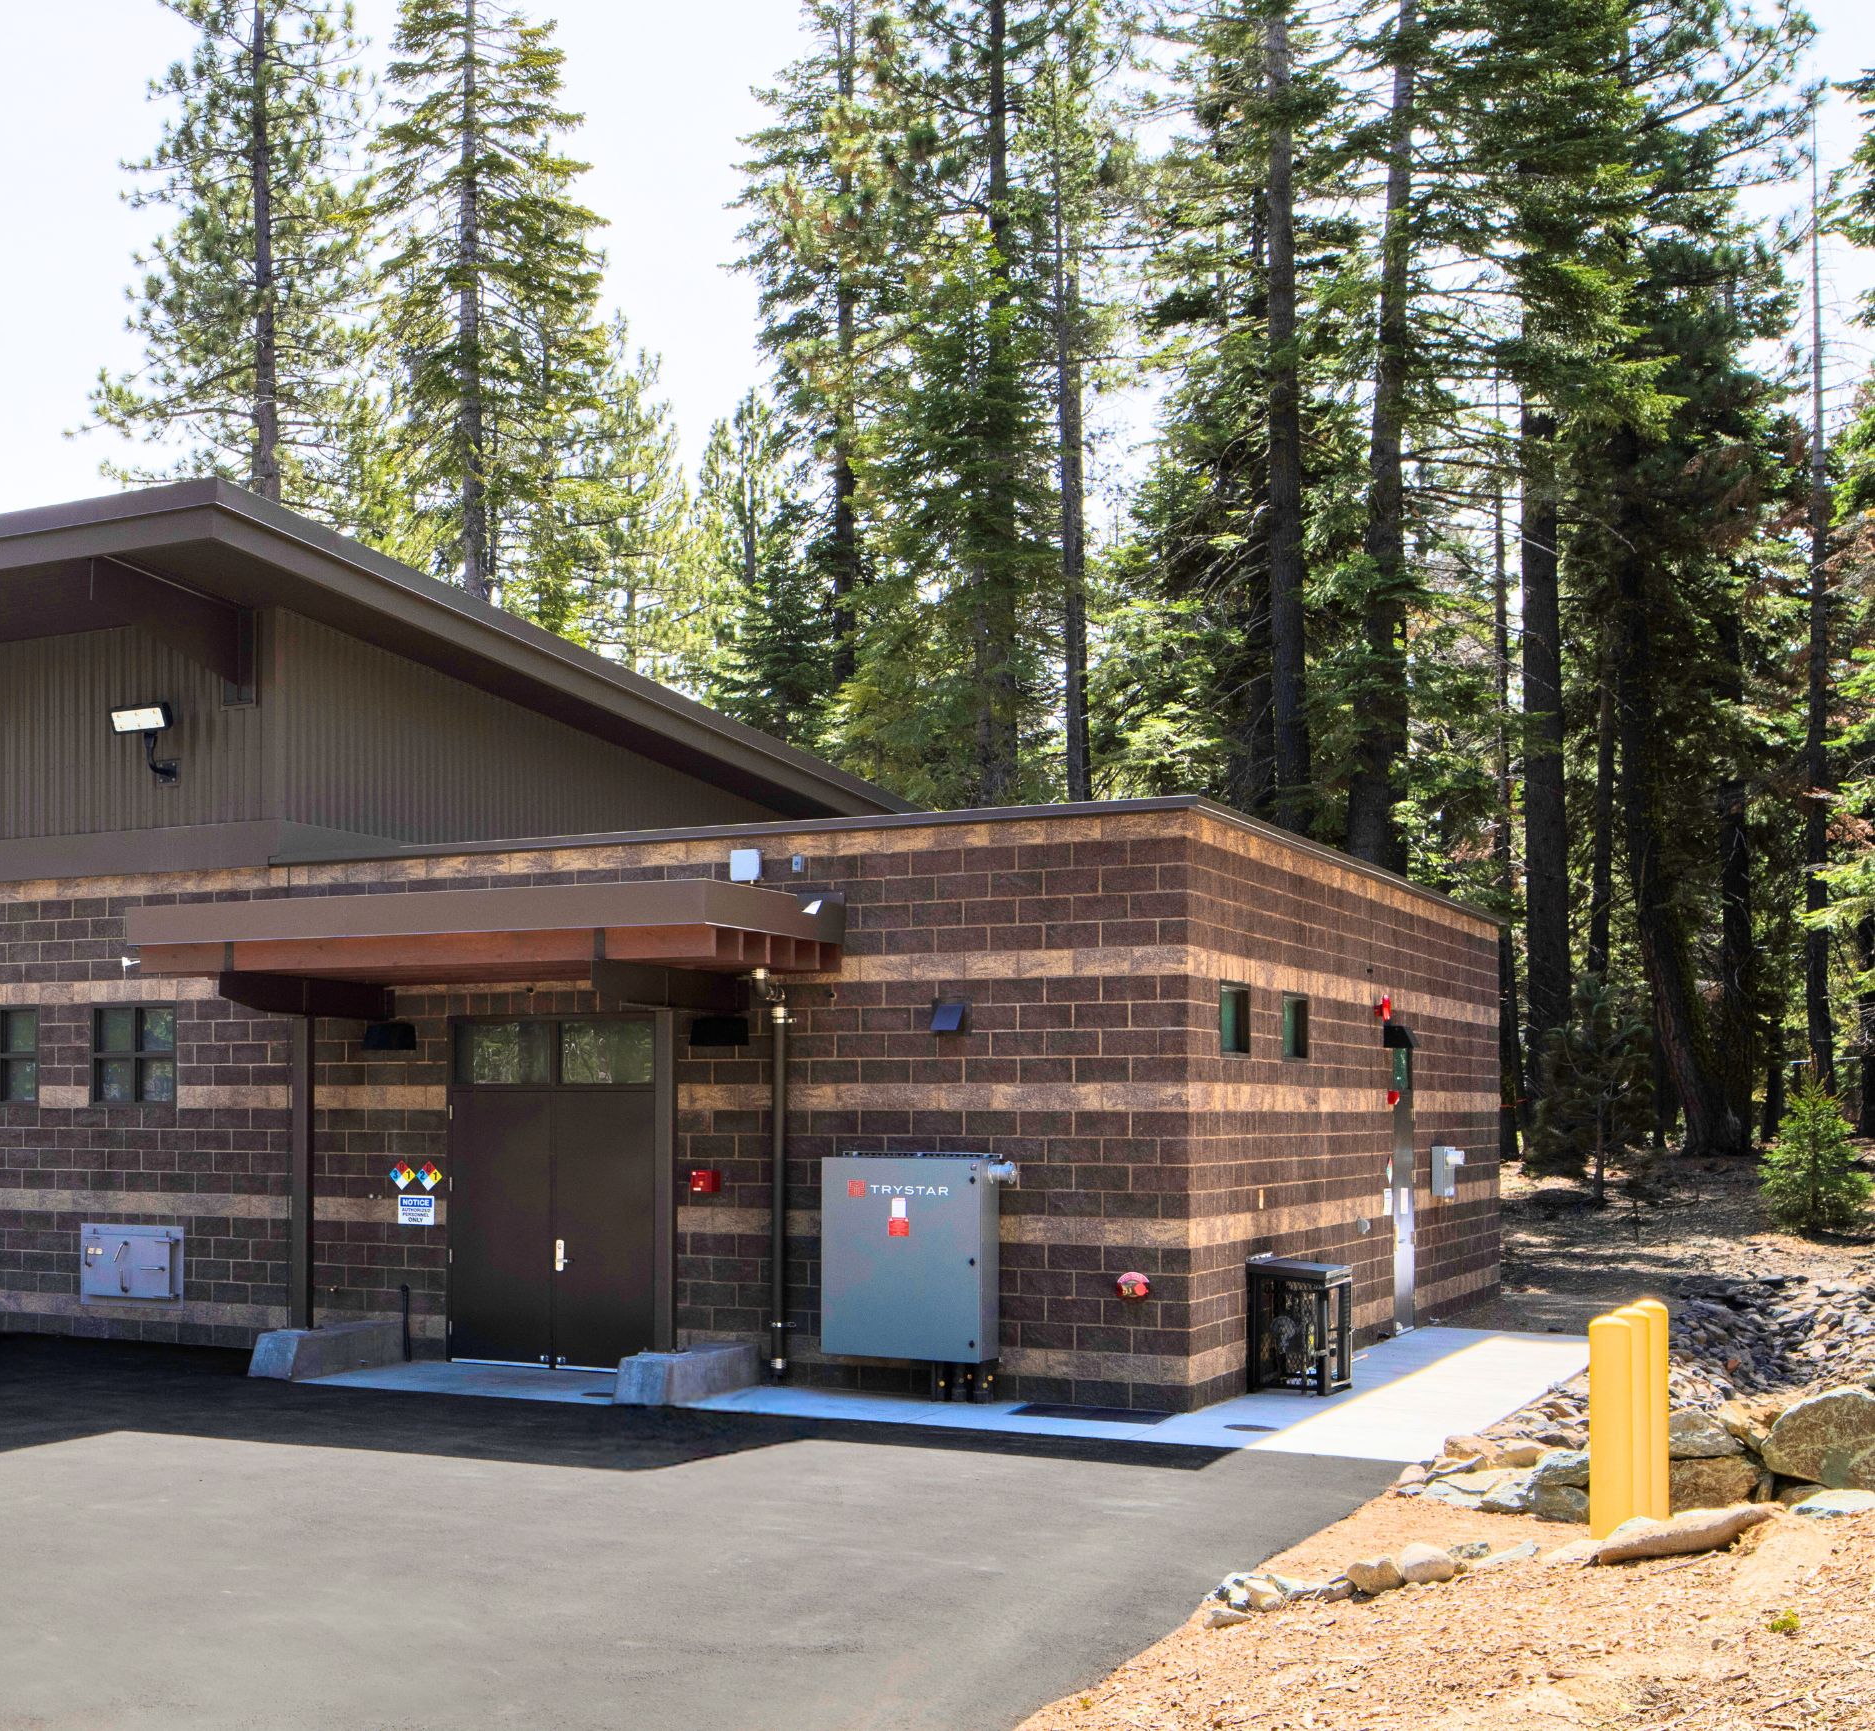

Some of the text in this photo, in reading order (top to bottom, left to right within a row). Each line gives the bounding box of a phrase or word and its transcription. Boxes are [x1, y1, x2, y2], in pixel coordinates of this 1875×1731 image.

[399, 1163, 404, 1172] 0
[426, 1164, 431, 1173] 0
[392, 1170, 398, 1179] 3
[406, 1171, 411, 1180] 1
[420, 1171, 425, 1180] 2
[433, 1172, 437, 1181] 1
[870, 1184, 949, 1196] TRYSTAR
